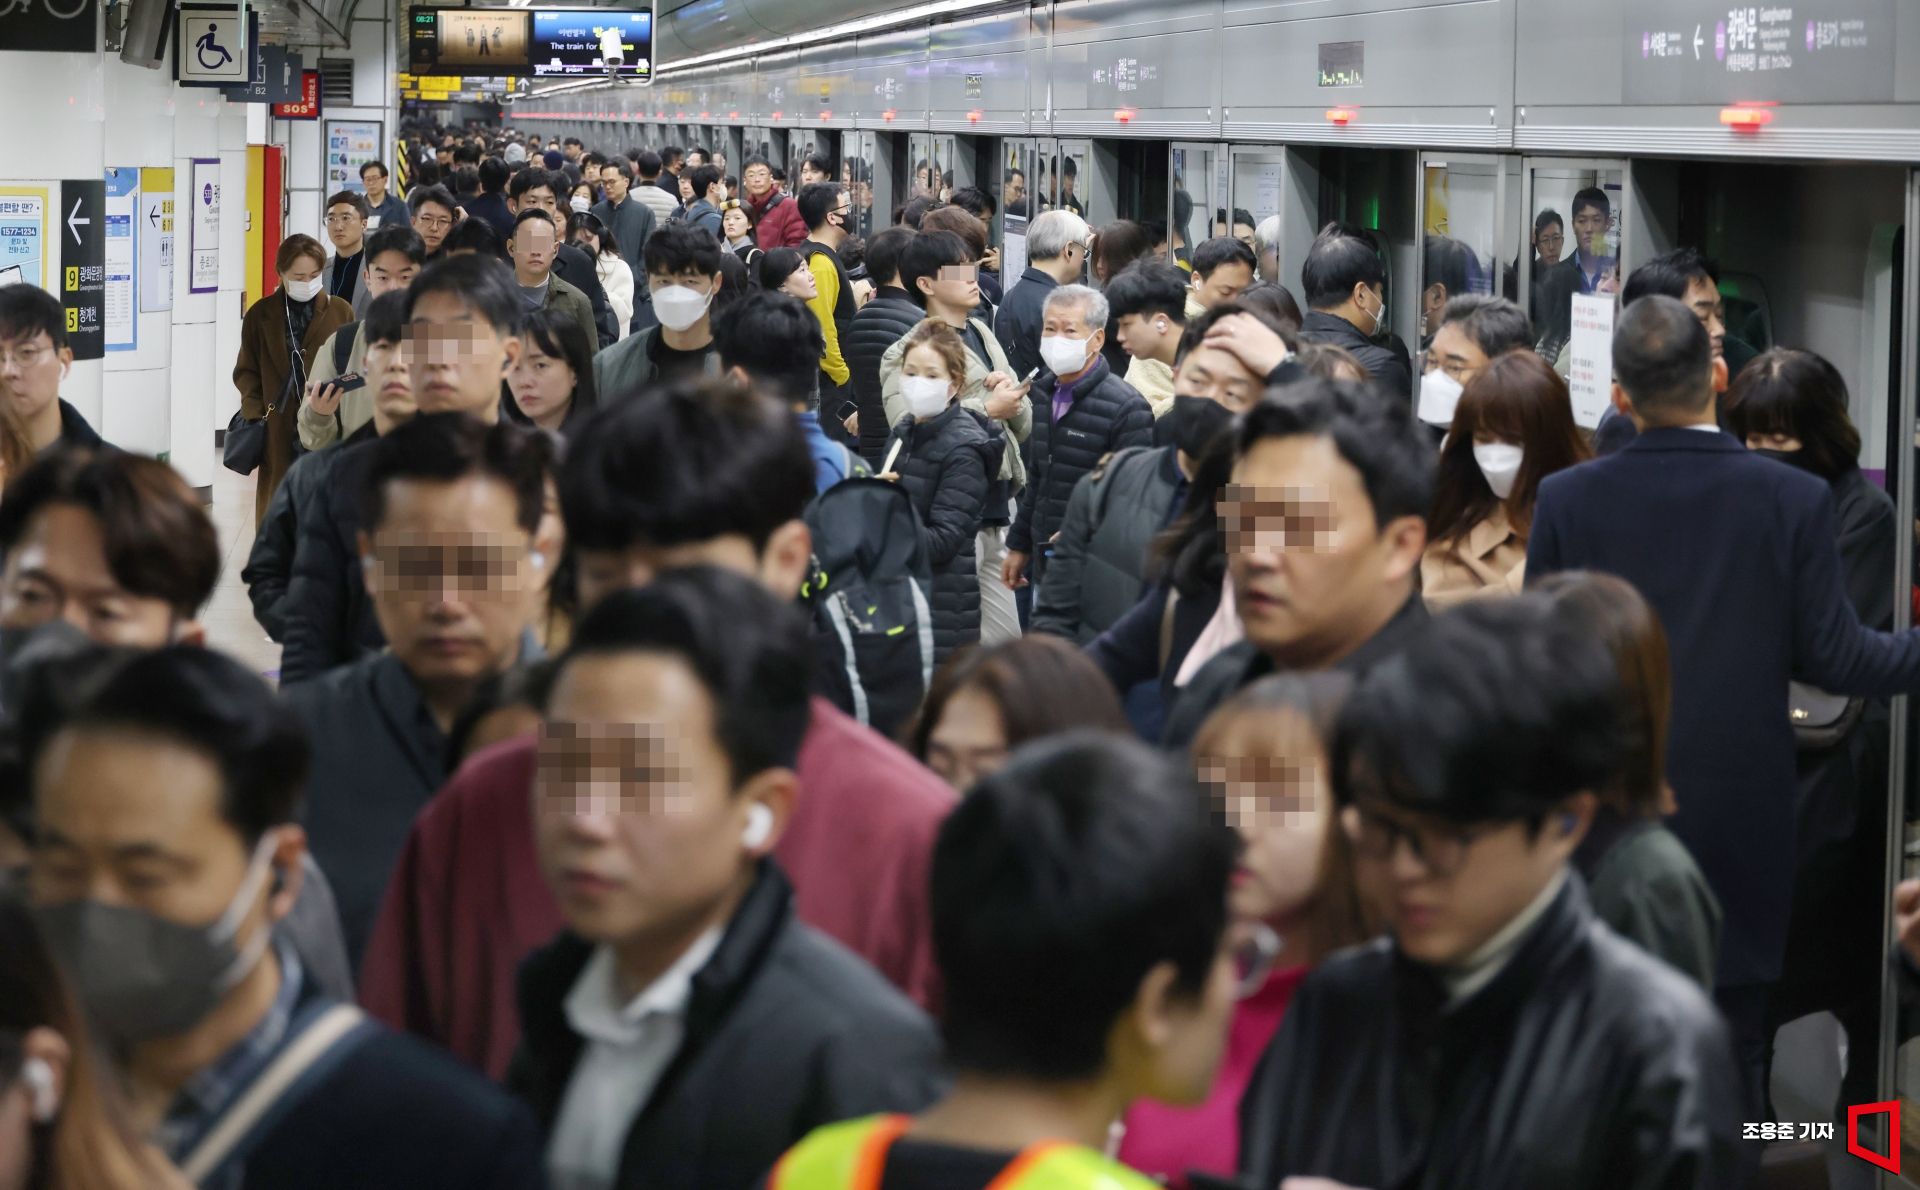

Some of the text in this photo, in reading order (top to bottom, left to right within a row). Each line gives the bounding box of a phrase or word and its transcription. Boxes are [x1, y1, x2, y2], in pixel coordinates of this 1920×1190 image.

[1727, 8, 1757, 50] 광화문
[550, 42, 564, 50] The
[567, 42, 584, 50] train
[586, 42, 598, 50] for
[255, 87, 266, 95] B2
[284, 104, 308, 113] SOS
[3, 228, 36, 236] 1577-1234
[69, 270, 76, 287] 9
[68, 311, 75, 329] 5
[80, 306, 97, 323] 청계천
